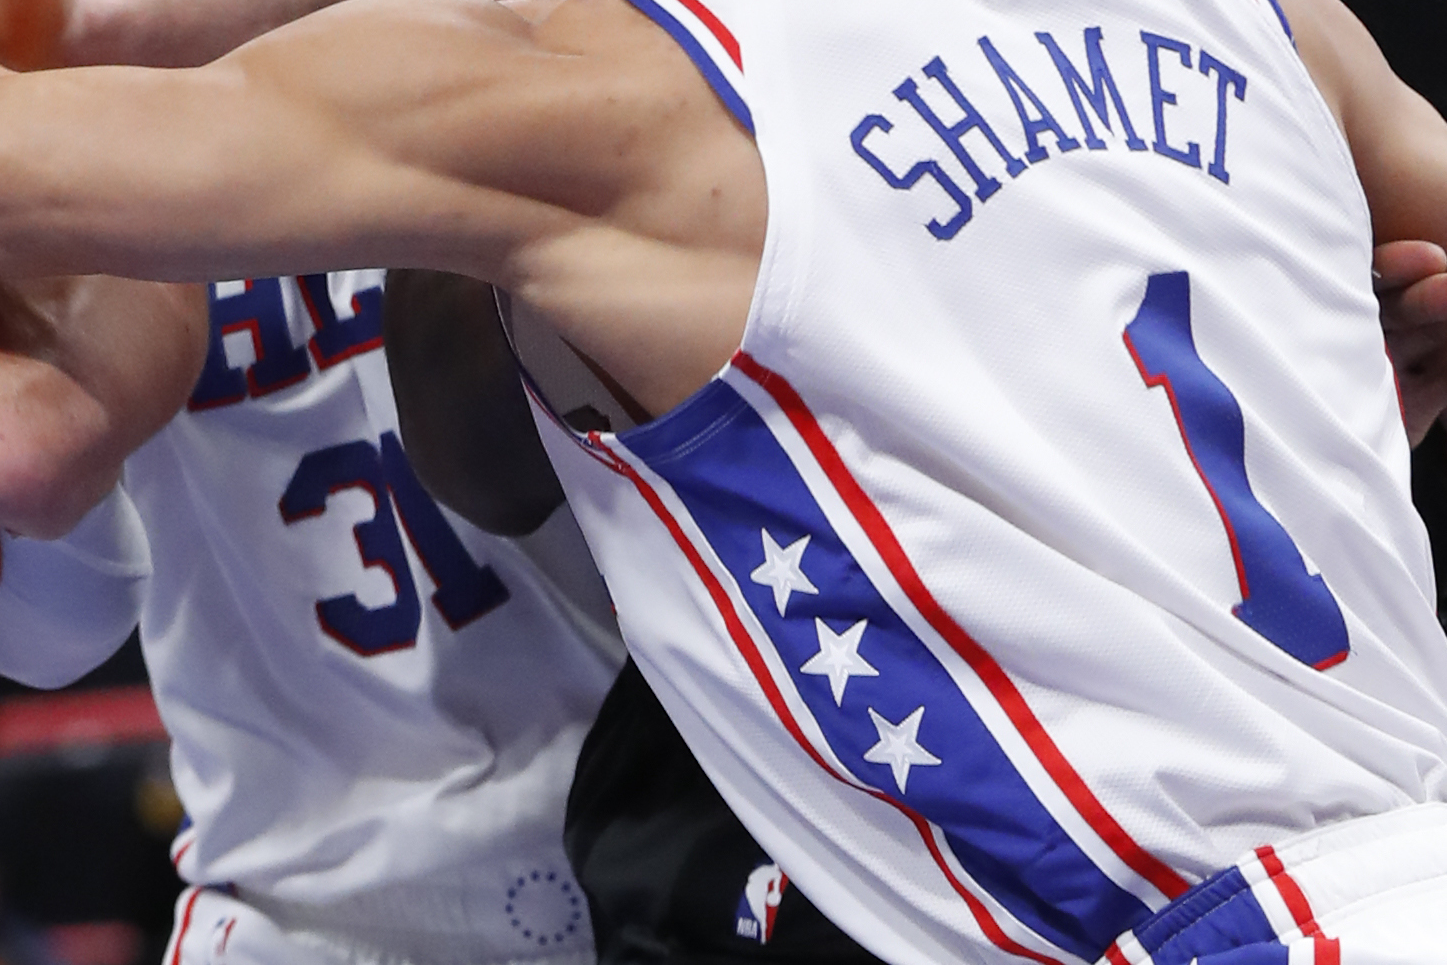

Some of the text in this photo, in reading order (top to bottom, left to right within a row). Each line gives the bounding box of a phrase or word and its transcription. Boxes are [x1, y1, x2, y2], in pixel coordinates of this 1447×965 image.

[849, 26, 1248, 242] SHAMET
[278, 430, 511, 657] 31
[1122, 270, 1351, 673] 1
[736, 916, 758, 940] NBA
